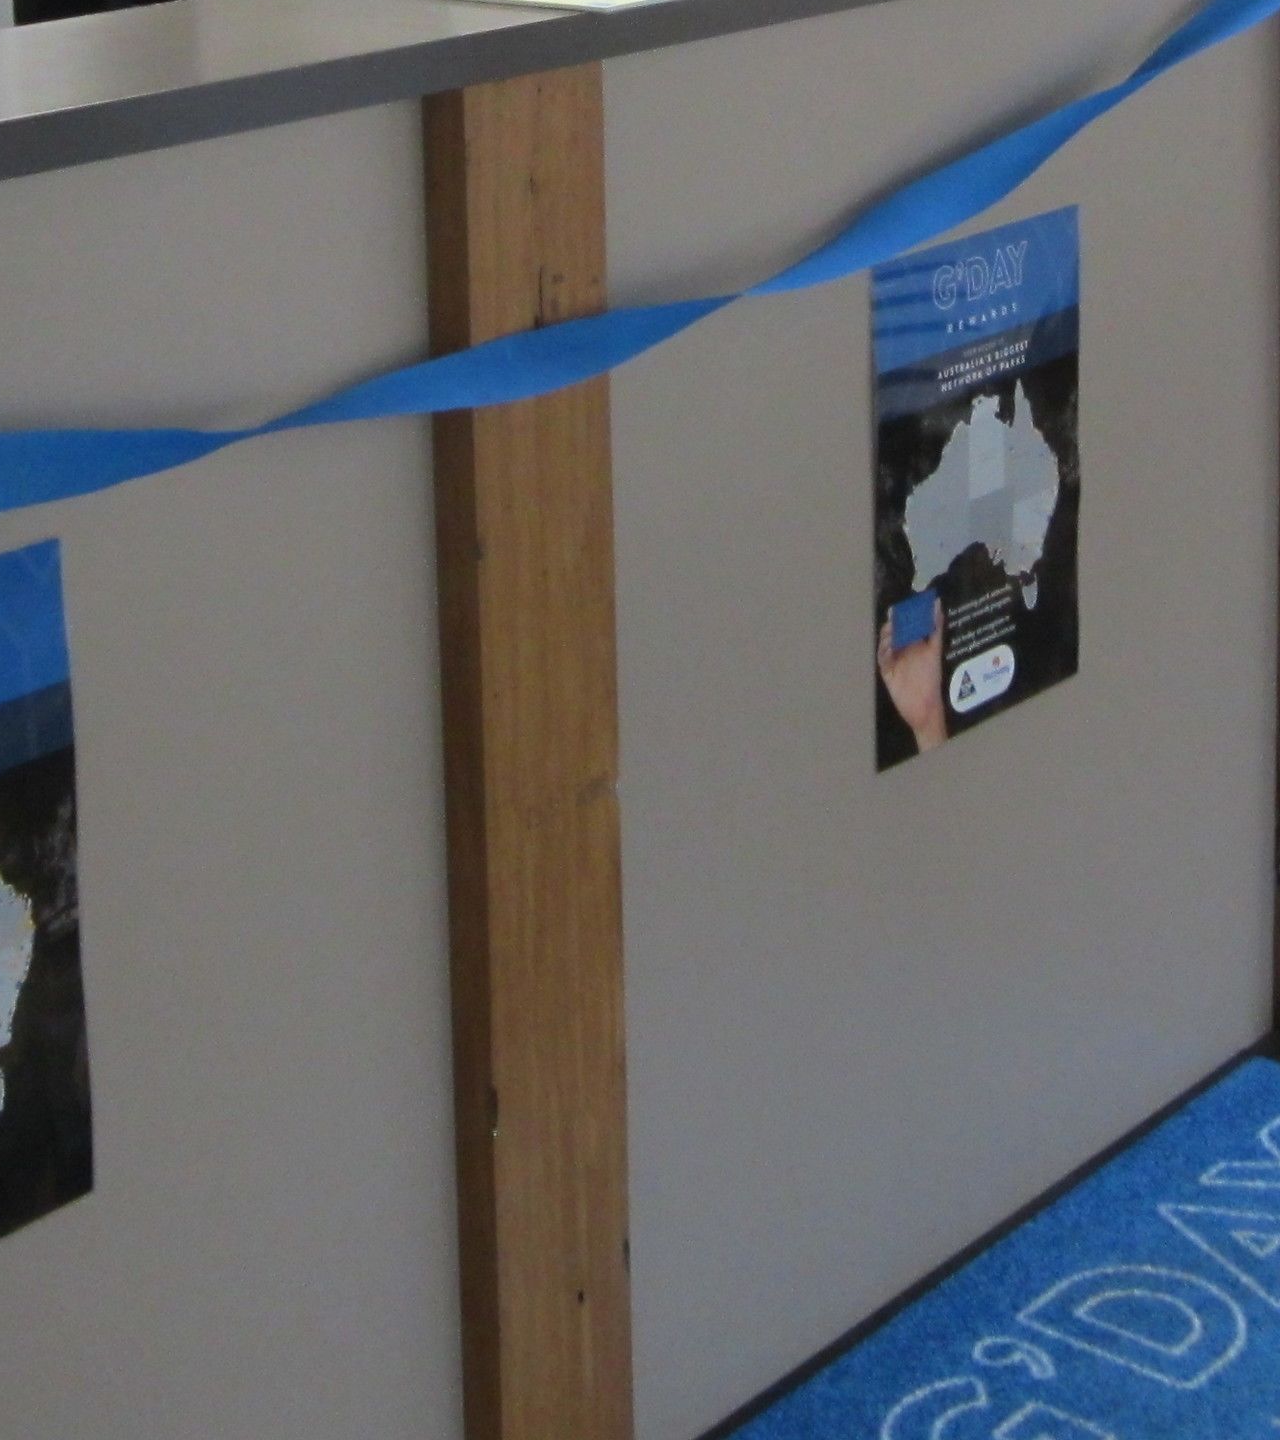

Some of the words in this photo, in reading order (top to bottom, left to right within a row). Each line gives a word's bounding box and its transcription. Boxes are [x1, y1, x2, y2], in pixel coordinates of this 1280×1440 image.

[932, 240, 1029, 310] G'DAY
[946, 302, 1017, 334] REWARDS
[999, 354, 1025, 371] PARKS
